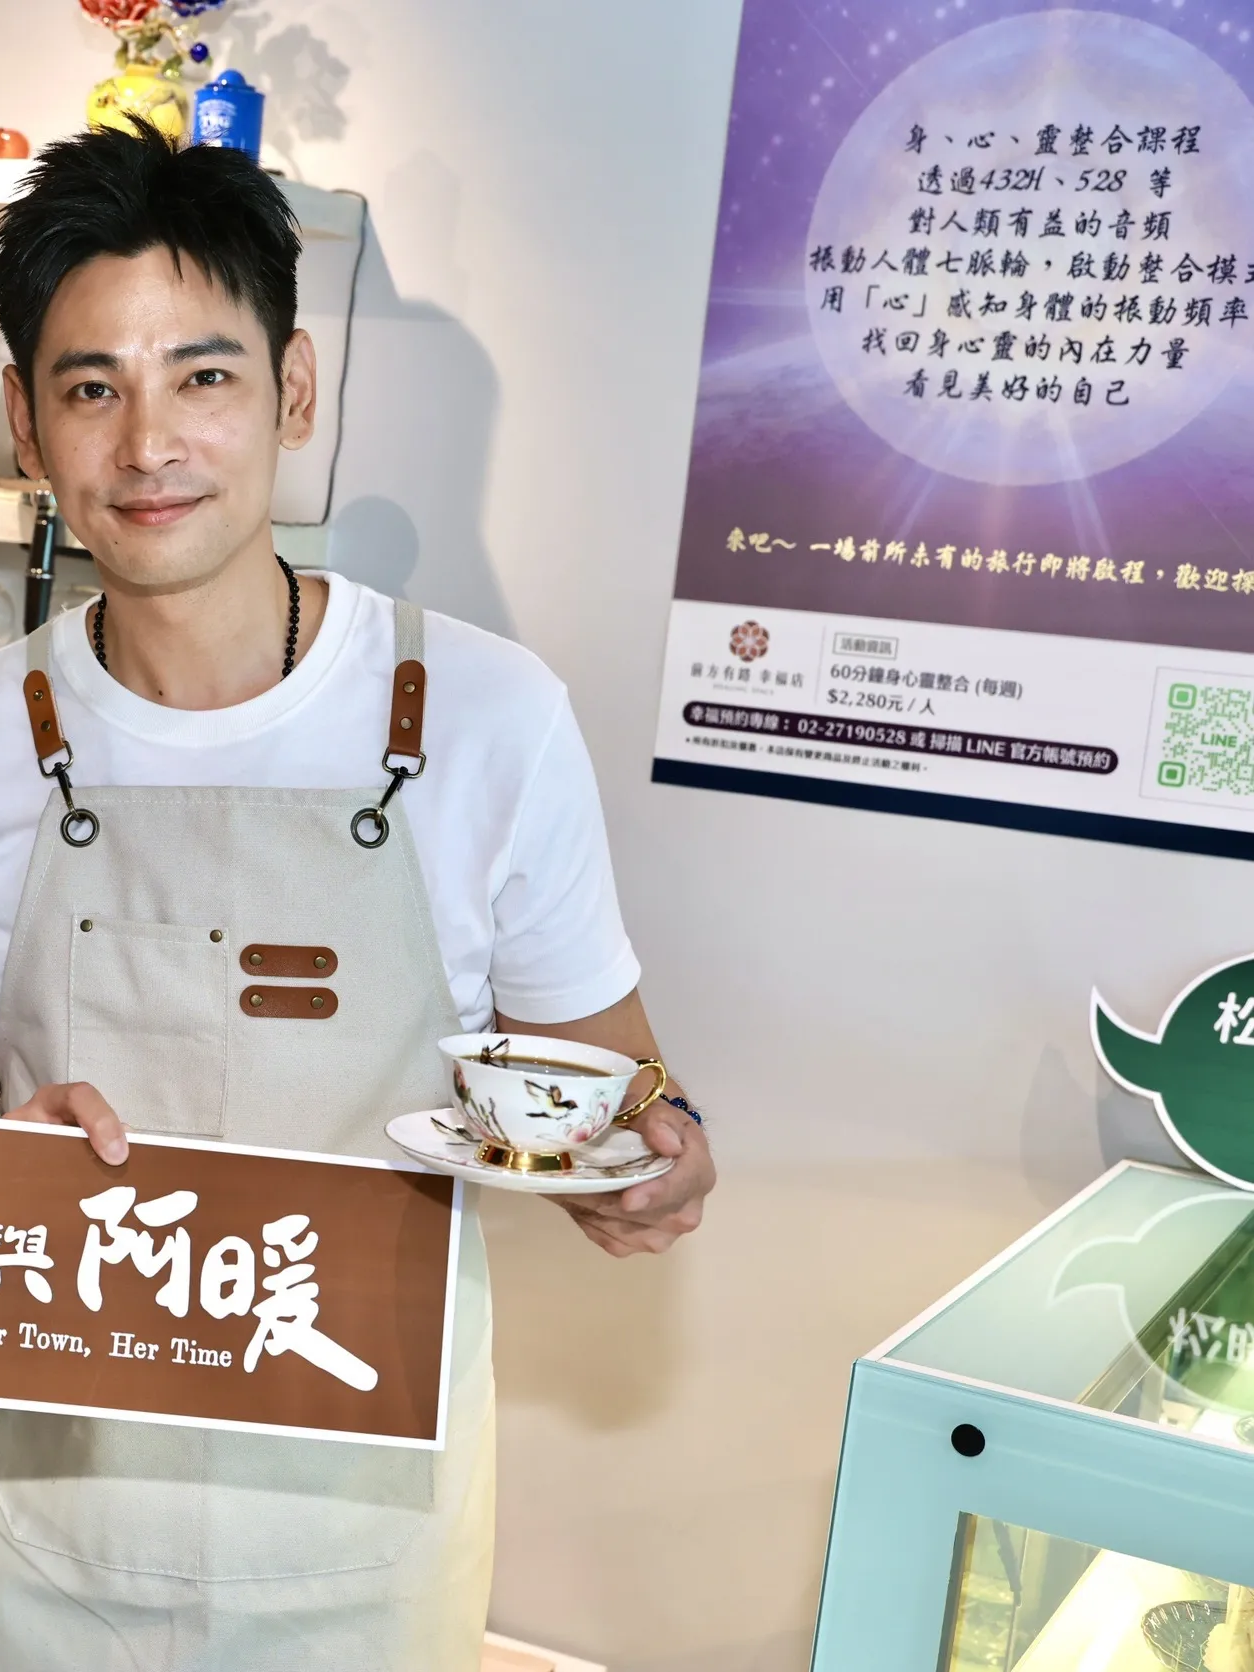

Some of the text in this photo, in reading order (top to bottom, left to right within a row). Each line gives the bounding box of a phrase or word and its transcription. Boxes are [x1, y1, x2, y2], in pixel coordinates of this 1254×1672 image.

[904, 123, 1202, 156] 身、心、靈整合課程
[1148, 166, 1172, 198] 等
[907, 207, 1173, 241] 對人類有益的音頻
[861, 327, 1190, 370] 找回身心靈的內在力量
[903, 367, 1130, 407] 看見美好的自己
[829, 663, 970, 694] 60分鐘身心靈整合
[826, 688, 904, 713] $2,280元
[919, 698, 936, 716] 人
[797, 717, 907, 746] 02-27190528
[966, 738, 1007, 758] LINE
[1200, 732, 1238, 748] LINE
[18, 1322, 92, 1358] Town,
[108, 1331, 160, 1361] Her
[170, 1337, 233, 1368] Time
